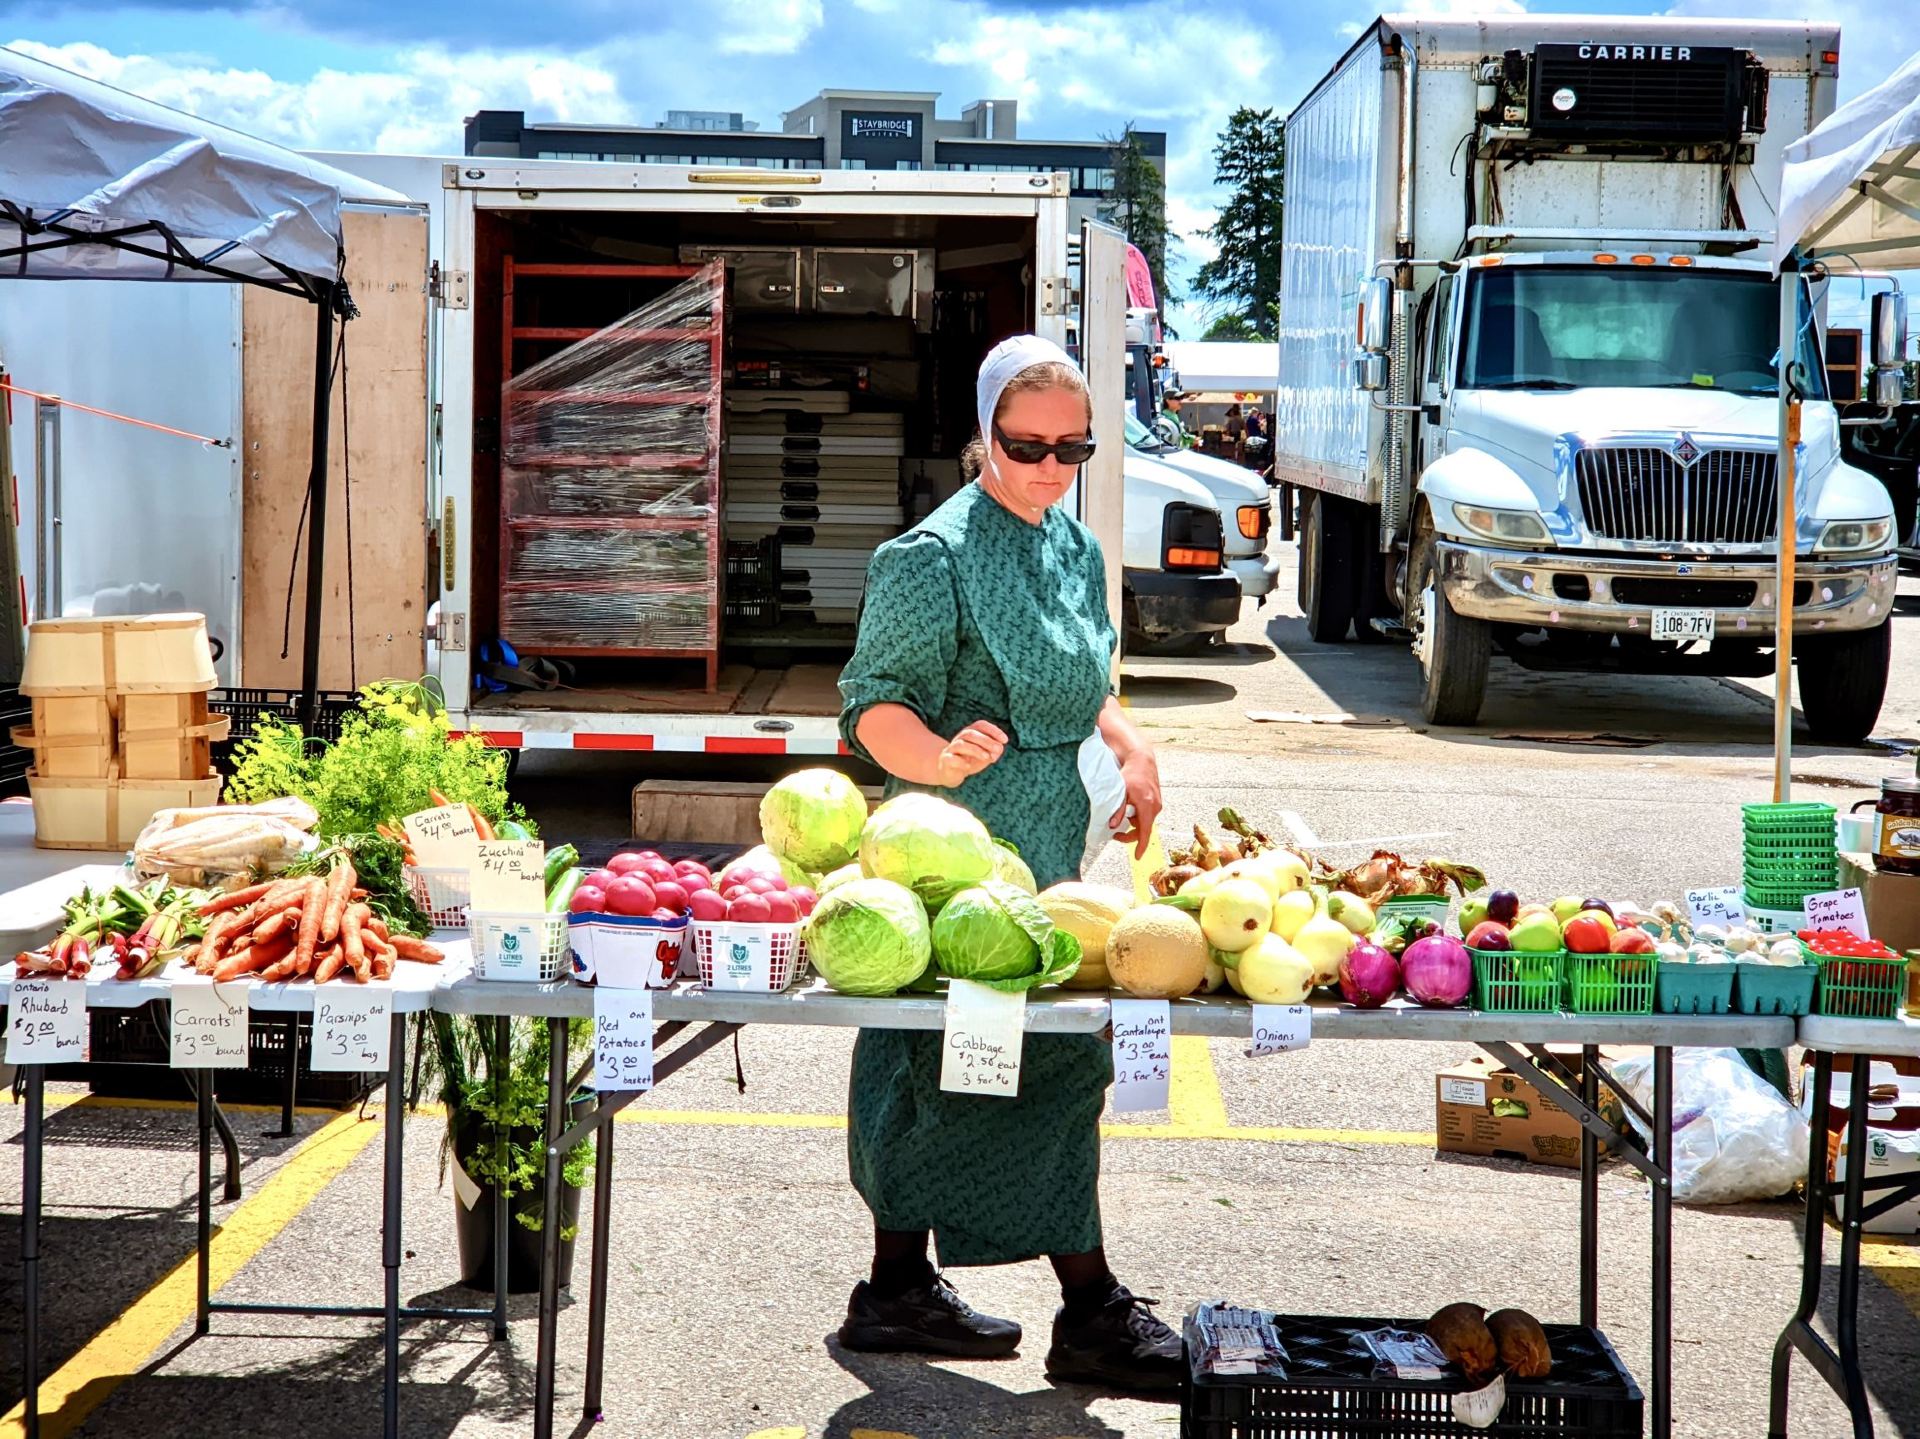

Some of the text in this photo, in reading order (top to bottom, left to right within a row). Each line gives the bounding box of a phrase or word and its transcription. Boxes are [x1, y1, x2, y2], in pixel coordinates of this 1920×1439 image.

[1578, 46, 1691, 61] CARRIER
[858, 119, 906, 129] STAYBRIDGE
[414, 811, 451, 828] Carrots
[477, 845, 525, 858] Zucchini
[1688, 891, 1720, 902] Garlic
[1807, 897, 1839, 912] Grape
[1809, 910, 1855, 925] Tomatoes
[20, 996, 69, 1015] Rhubarb
[174, 1008, 231, 1027] Carrots
[318, 1004, 368, 1027] Parsnips
[598, 1015, 619, 1034] Red
[56, 1034, 80, 1049] bunch
[1256, 1027, 1295, 1041] Onions
[215, 1044, 246, 1056] bunch
[598, 1035, 646, 1051] Potatoes
[950, 1031, 1006, 1059] Cabbage
[361, 1047, 379, 1064] bag
[1149, 1051, 1169, 1060] each
[997, 1061, 1018, 1070] each
[622, 1074, 651, 1085] basket
[962, 1072, 971, 1086] 3
[977, 1073, 993, 1084] for
[1118, 1070, 1127, 1085] 2
[1152, 1064, 1168, 1080] $5
